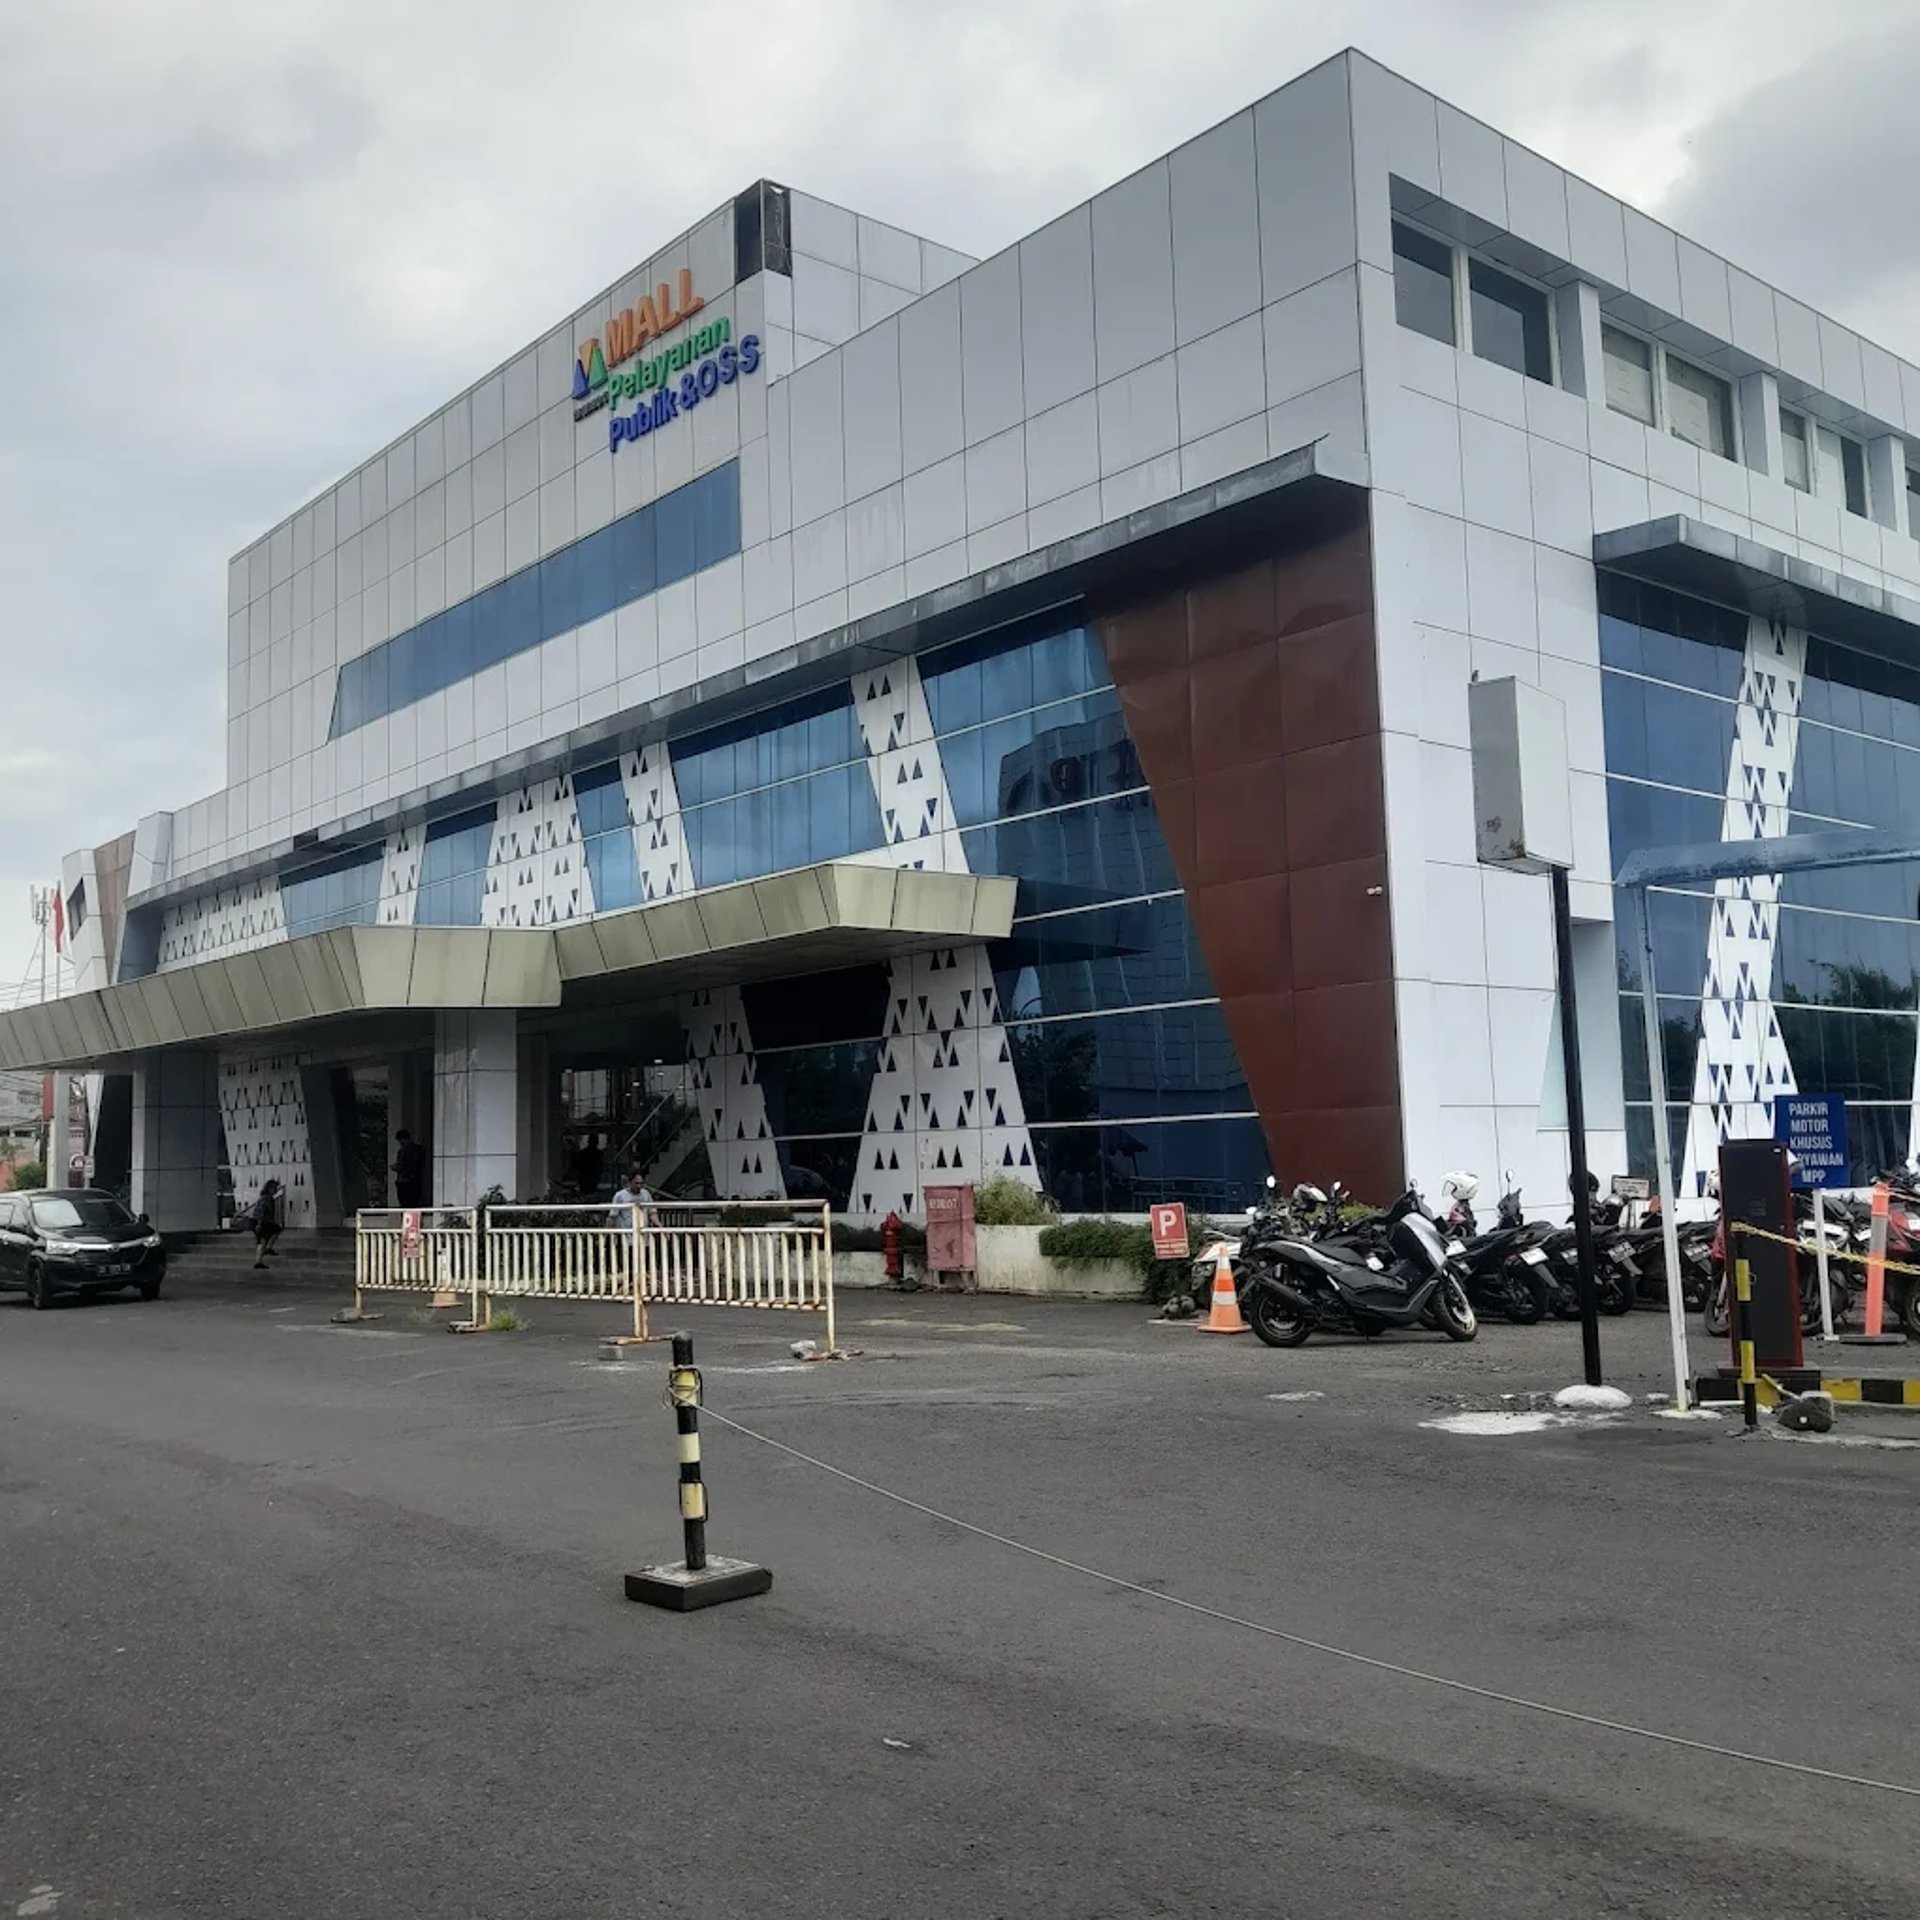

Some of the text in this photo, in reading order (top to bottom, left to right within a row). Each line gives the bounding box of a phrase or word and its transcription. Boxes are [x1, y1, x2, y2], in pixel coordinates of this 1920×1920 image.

[605, 268, 705, 369] MALL
[608, 316, 731, 410] Pelayanan
[609, 387, 679, 454] Publik
[1789, 1103, 1828, 1116] PARKIR
[1790, 1119, 1829, 1132] MOTOR
[1789, 1136, 1833, 1149] KHUSUS
[1796, 1152, 1844, 1166] RYAWAN
[1801, 1170, 1826, 1183] MPP
[1159, 1210, 1177, 1236] P
